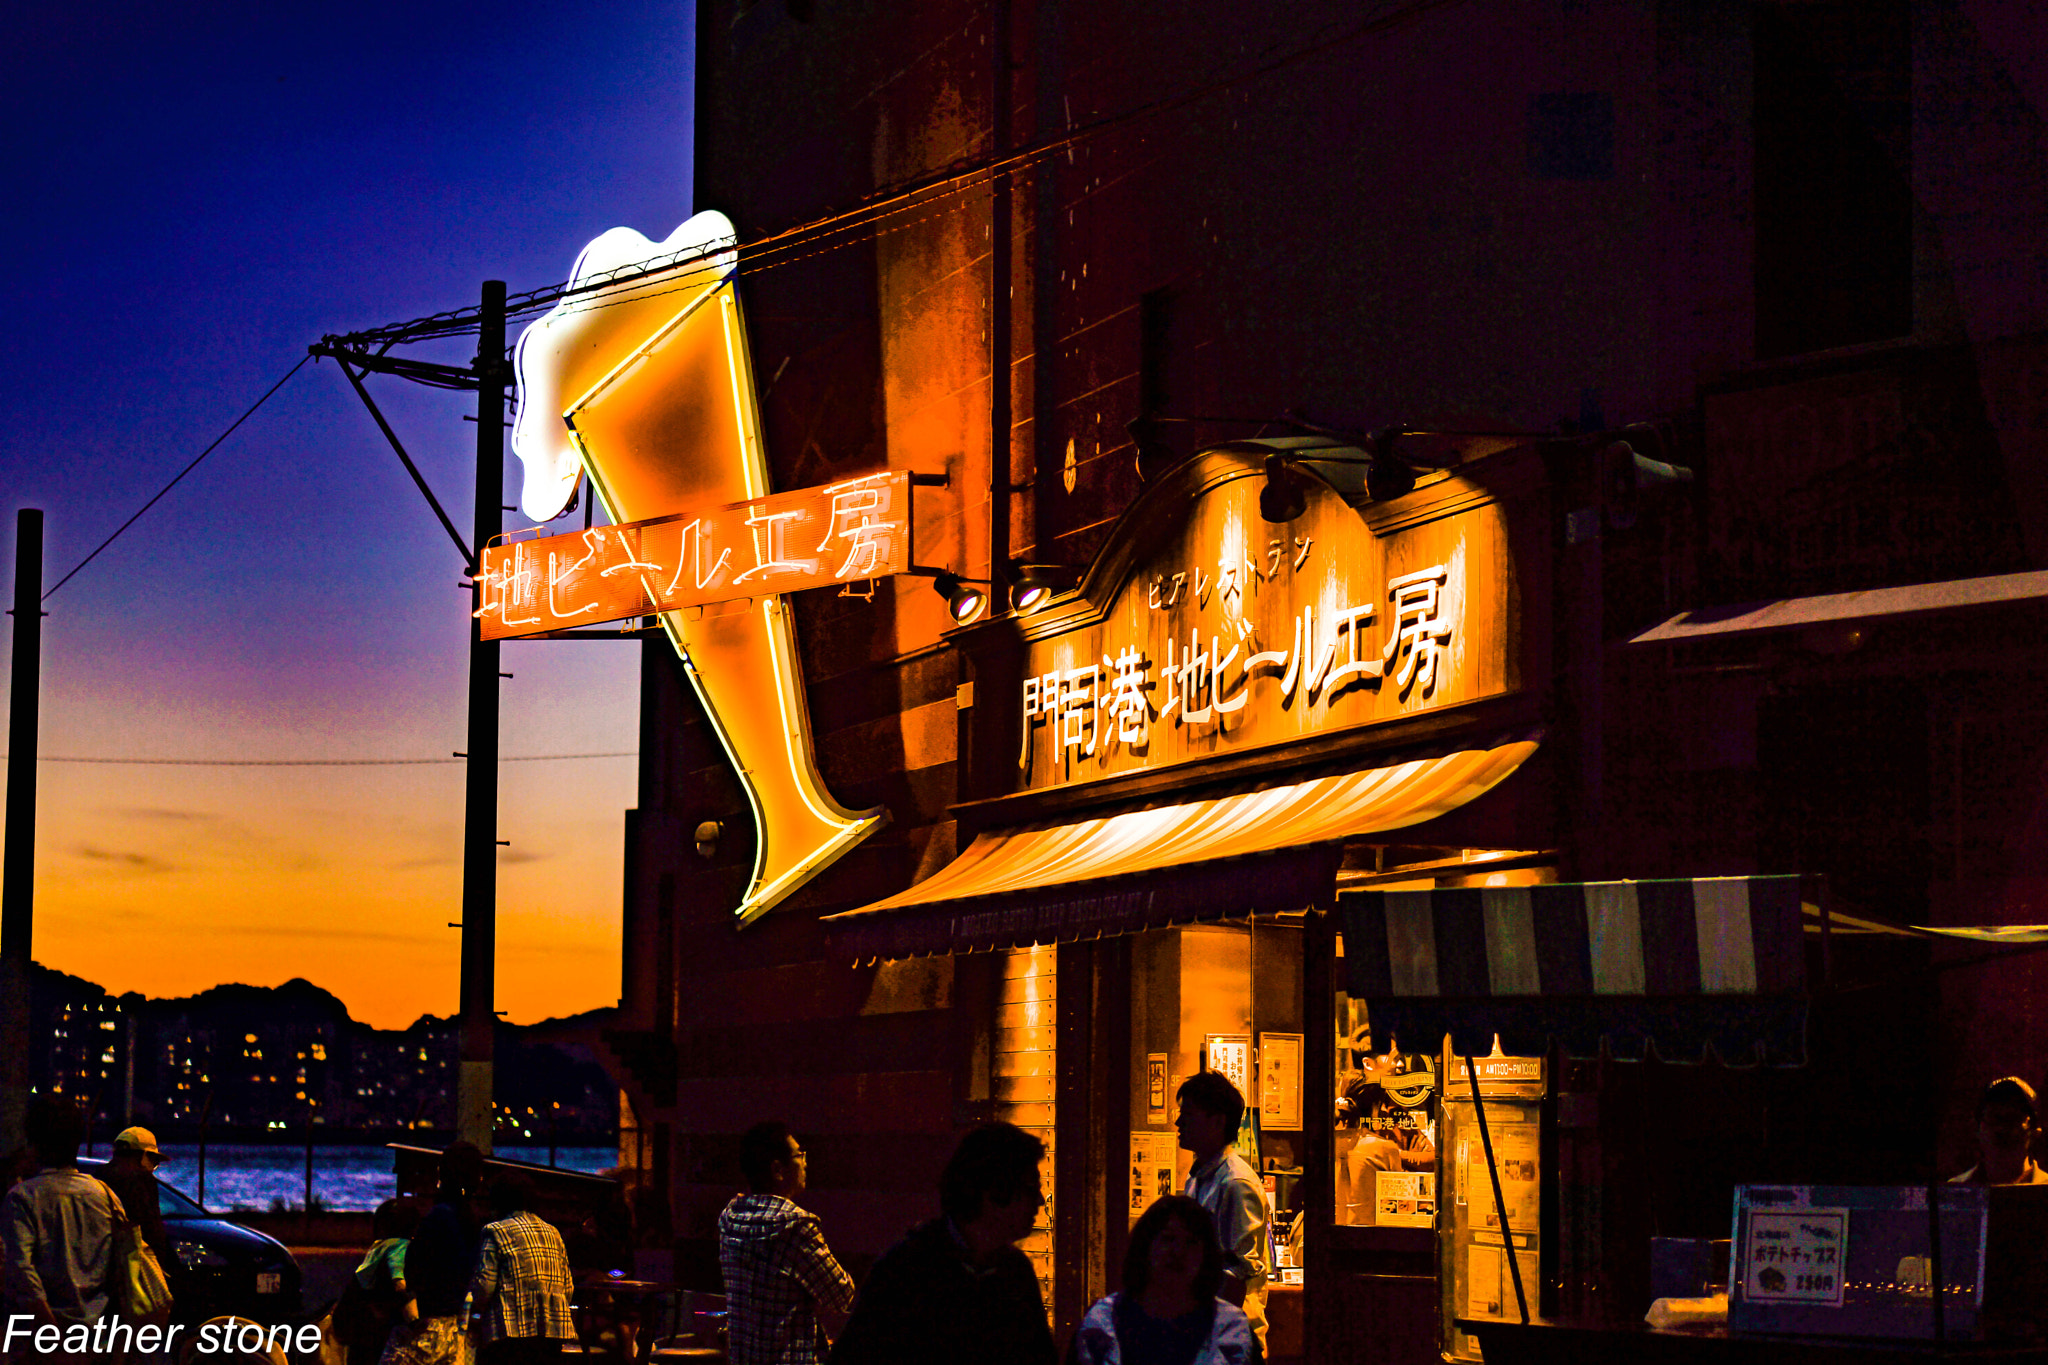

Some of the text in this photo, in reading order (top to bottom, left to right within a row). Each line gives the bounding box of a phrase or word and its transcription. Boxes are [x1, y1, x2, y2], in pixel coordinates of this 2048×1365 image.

[472, 472, 896, 626] 地ビール工房
[1148, 536, 1314, 610] ビアレストラン
[1018, 564, 1449, 769] 門司港地ビール工房
